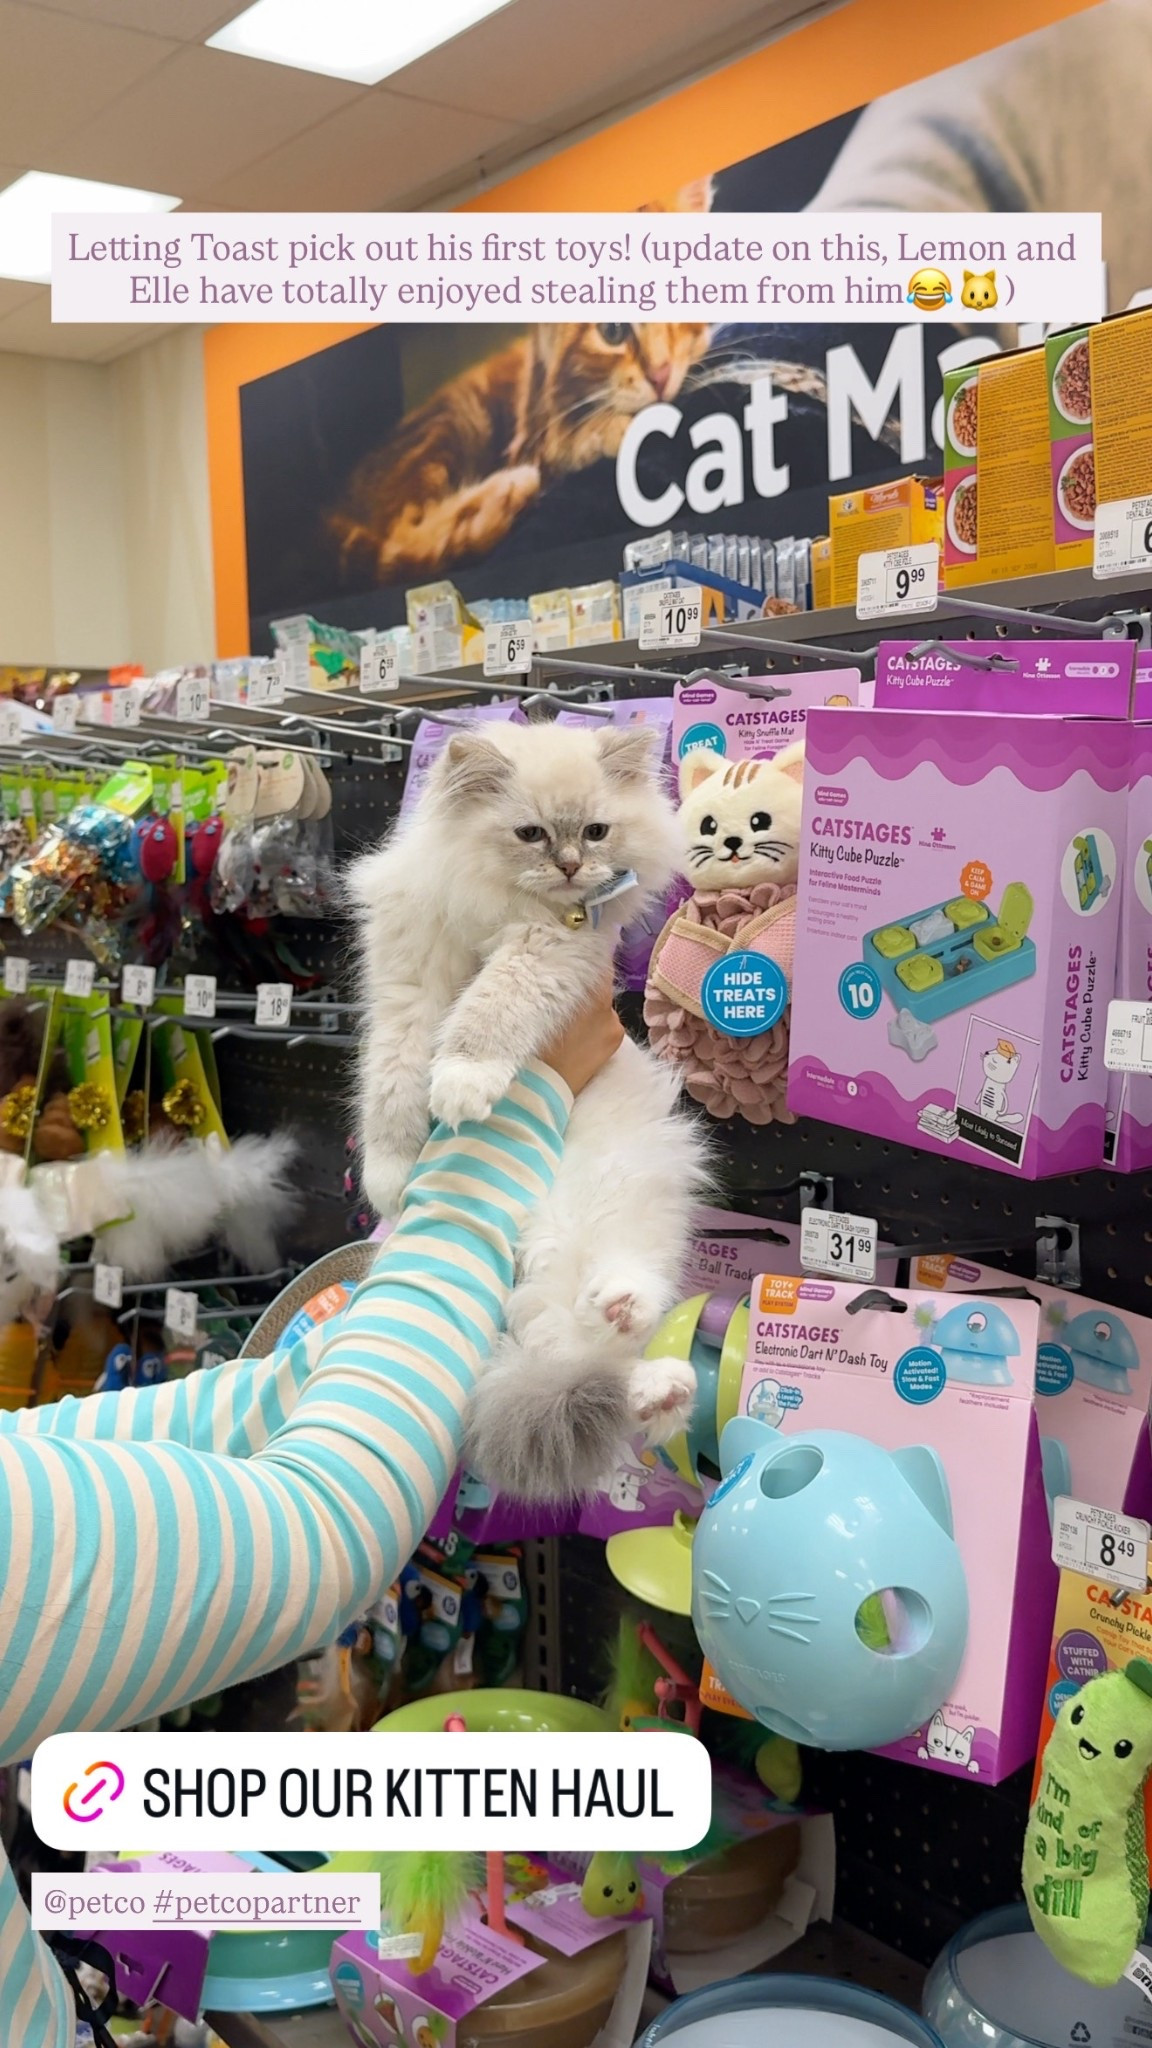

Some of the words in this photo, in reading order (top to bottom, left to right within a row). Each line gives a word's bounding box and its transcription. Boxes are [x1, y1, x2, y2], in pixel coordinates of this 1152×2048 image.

[616, 376, 789, 527] Cat
[886, 675, 904, 688] Kitty
[905, 675, 924, 687] Cube
[726, 709, 806, 726] CATSTAGES
[738, 728, 755, 740] Kitty
[756, 727, 780, 738] Snuffle
[780, 727, 795, 736] Mat
[685, 735, 718, 751] TREAT
[830, 791, 847, 799] Games
[811, 816, 912, 846] CATSTAGES
[810, 842, 834, 864] Kitty
[836, 846, 863, 864] Cube
[864, 848, 900, 868] Puzzle
[809, 868, 844, 881] Interactive
[844, 873, 861, 883] Food
[861, 875, 882, 886] Puzzle
[968, 874, 985, 883] CALM
[971, 867, 985, 875] KEEP
[808, 878, 818, 887] for
[818, 880, 838, 890] Feline
[838, 883, 882, 897] Masterminds
[723, 972, 762, 986] HIDE
[1082, 956, 1097, 1004] Puzzle
[713, 987, 776, 1003] TREATS
[848, 982, 874, 1009] 10
[723, 1005, 766, 1019] HERE
[1060, 944, 1083, 1083] CATSTAGES
[1079, 1006, 1094, 1038] Cube
[1077, 1046, 1093, 1081] Kitty
[960, 1117, 974, 1130] Most
[995, 1133, 1018, 1151] Succeed
[698, 1257, 722, 1275] Ball
[770, 1280, 793, 1289] TOY+
[813, 1287, 833, 1295] Games
[765, 1288, 795, 1300] TRACK
[756, 1321, 840, 1344] CATSTAGES
[755, 1341, 799, 1358] Electronic
[800, 1345, 823, 1361] Dart
[825, 1348, 837, 1362] N'
[838, 1350, 867, 1367] Dash
[870, 1353, 889, 1373] Toy
[903, 1367, 939, 1375] Activated!
[1075, 1511, 1097, 1526] CRUNCHY
[1089, 1608, 1125, 1634] Crunchy
[1125, 1622, 1152, 1642] Pickle
[1119, 1633, 1130, 1645] Toy
[1062, 1646, 1100, 1658] STUFFED
[1070, 1656, 1094, 1668] WITH
[1067, 1666, 1099, 1677] CATNIP
[1078, 1821, 1103, 1842] of
[1035, 1833, 1048, 1862] a
[1056, 1838, 1099, 1877] big
[1033, 1874, 1084, 1919] dill
